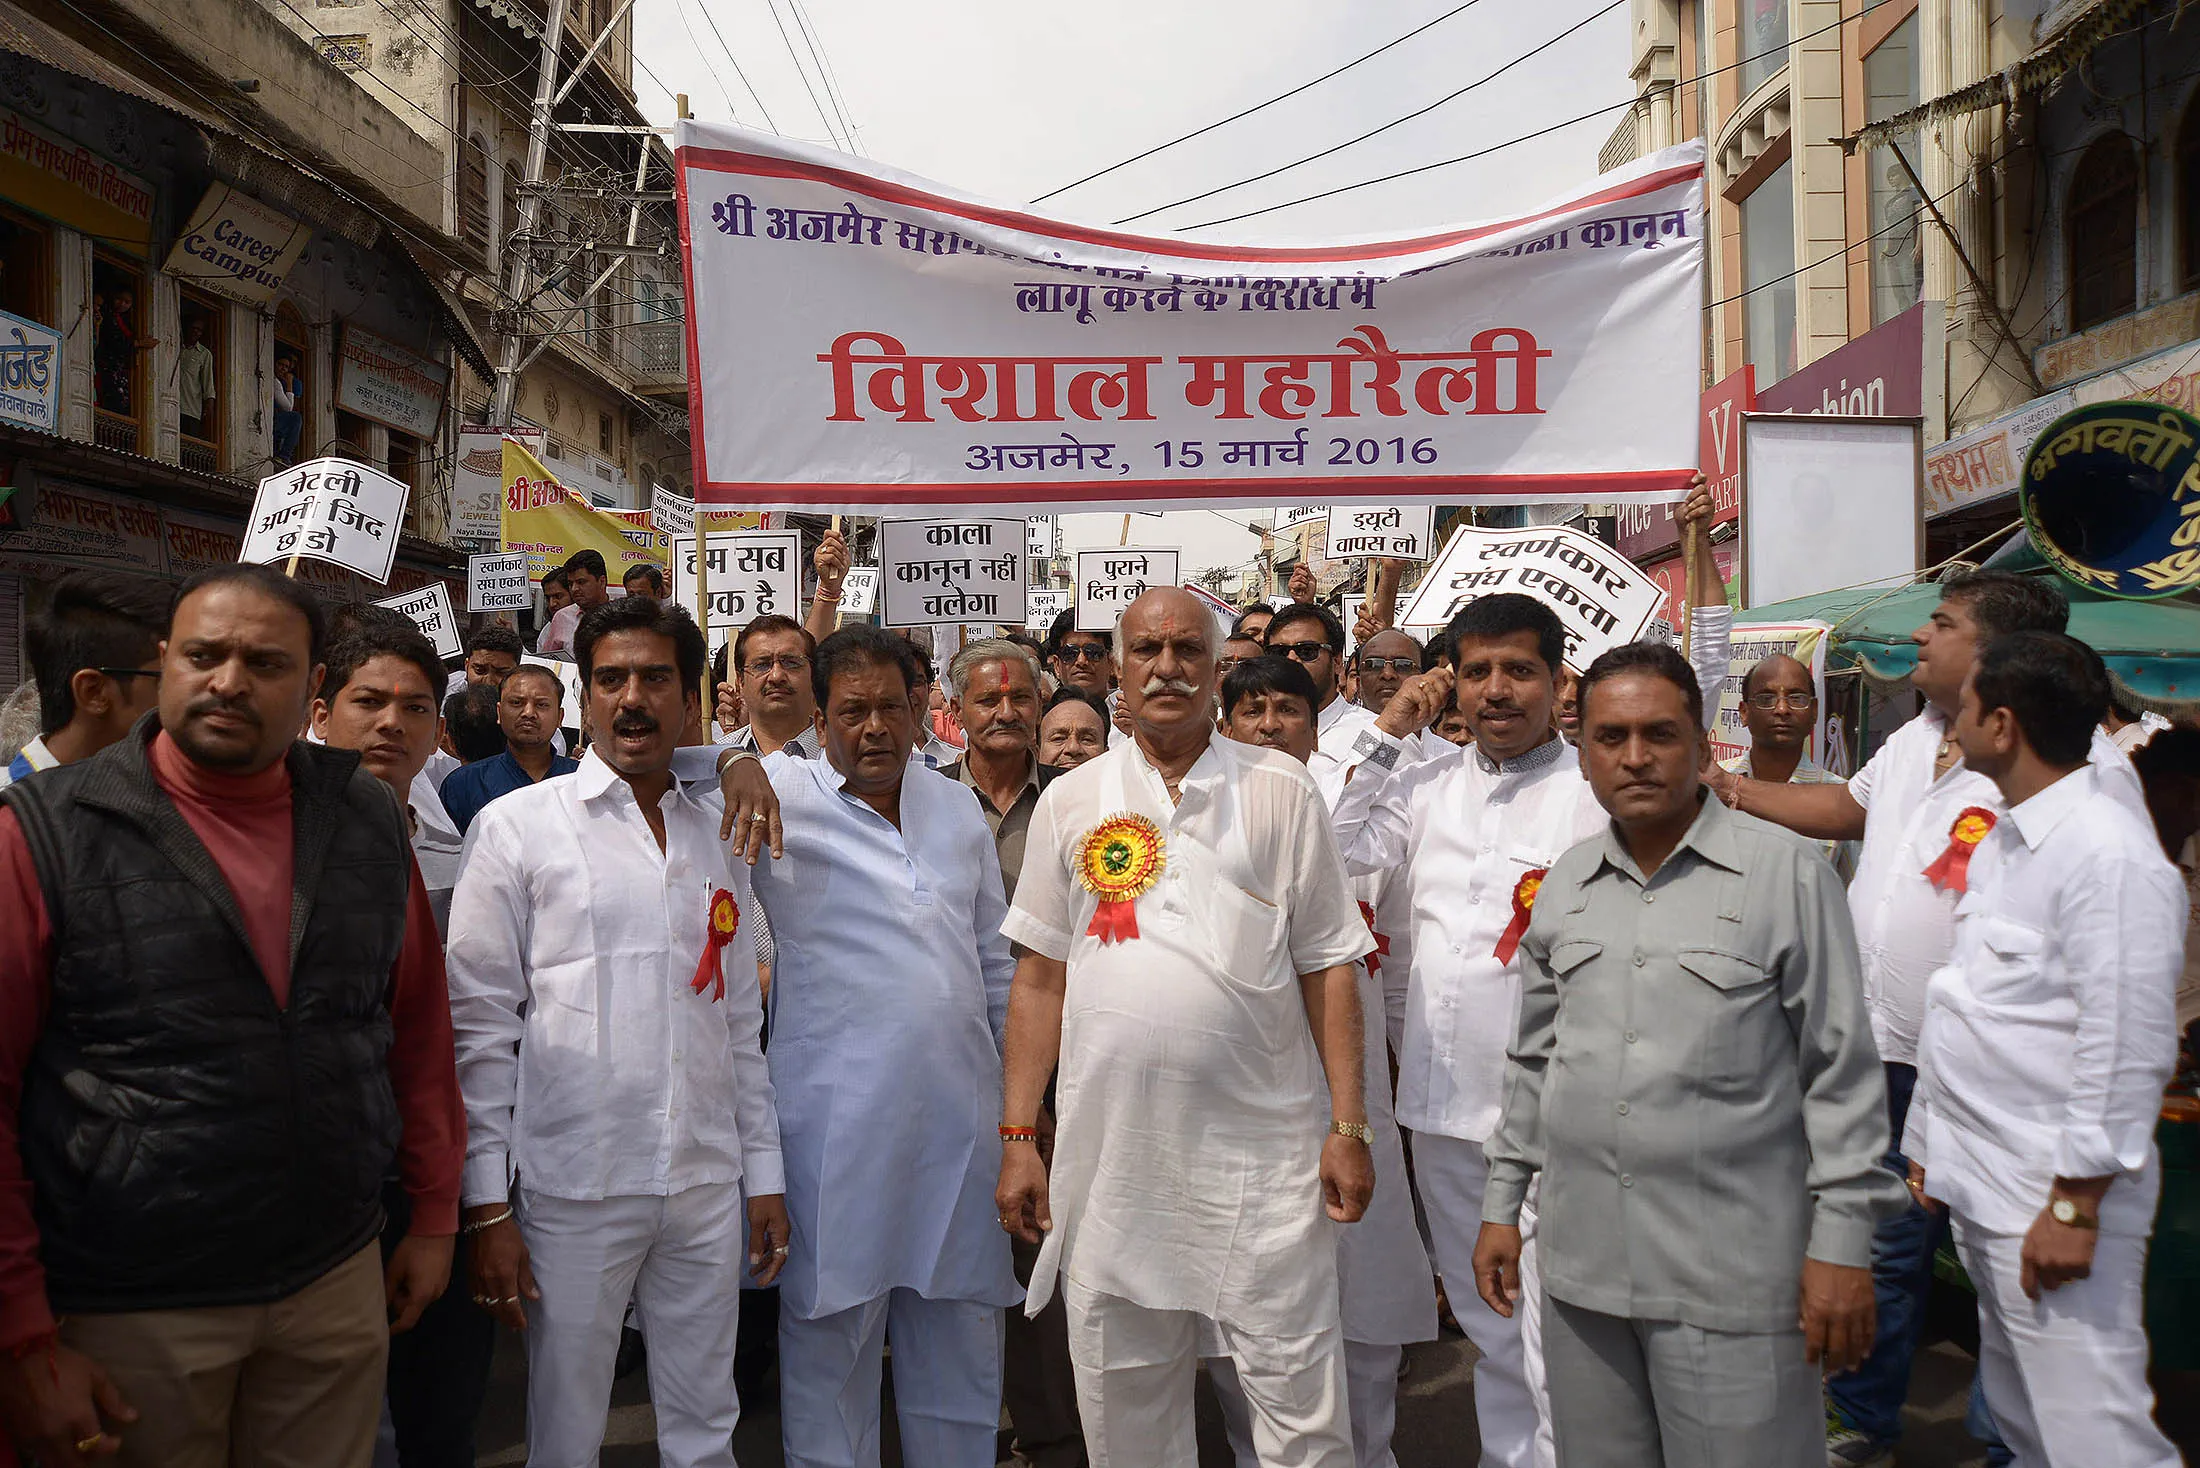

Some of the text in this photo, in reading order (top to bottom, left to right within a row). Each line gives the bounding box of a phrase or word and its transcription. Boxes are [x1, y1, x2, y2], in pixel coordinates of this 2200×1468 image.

[712, 193, 757, 237] श्री
[766, 202, 888, 245] अजमेर
[1577, 207, 1690, 250] कानून
[214, 219, 284, 264] Career
[183, 234, 282, 290] Campus
[1014, 283, 1097, 325] लागू
[816, 324, 1553, 423] विशाल महारैली
[1780, 376, 1884, 416] hion
[964, 427, 1439, 475] अजमेर, 15 मार्च 2016
[1709, 399, 1732, 475] V
[2031, 412, 2193, 481] भगवती
[287, 470, 363, 498] जेटली
[506, 476, 530, 511] श्री
[257, 495, 386, 541] अपनी जिद
[654, 504, 667, 517] संघ
[670, 511, 695, 530] एकता
[656, 493, 694, 516] स्वर्णकार
[1353, 508, 1402, 531] ड्यूटी
[456, 528, 474, 536] Naya
[924, 524, 993, 546] काला
[1336, 533, 1418, 554] वापस लो
[480, 557, 523, 573] स्वर्णकार
[684, 548, 729, 575] हम
[735, 546, 787, 573] सब
[895, 552, 1017, 587] कानून नहीं
[1104, 555, 1149, 580] पुराने
[1478, 535, 1632, 599] स्वर्णकार
[477, 576, 496, 590] संघ
[499, 575, 526, 589] एकता
[481, 592, 523, 606] जिंदाबाद
[754, 579, 777, 616] है
[1087, 580, 1117, 601] दिन
[922, 586, 999, 616] चलेगा
[1450, 566, 1513, 590] संघ
[1518, 567, 1621, 636] एकता
